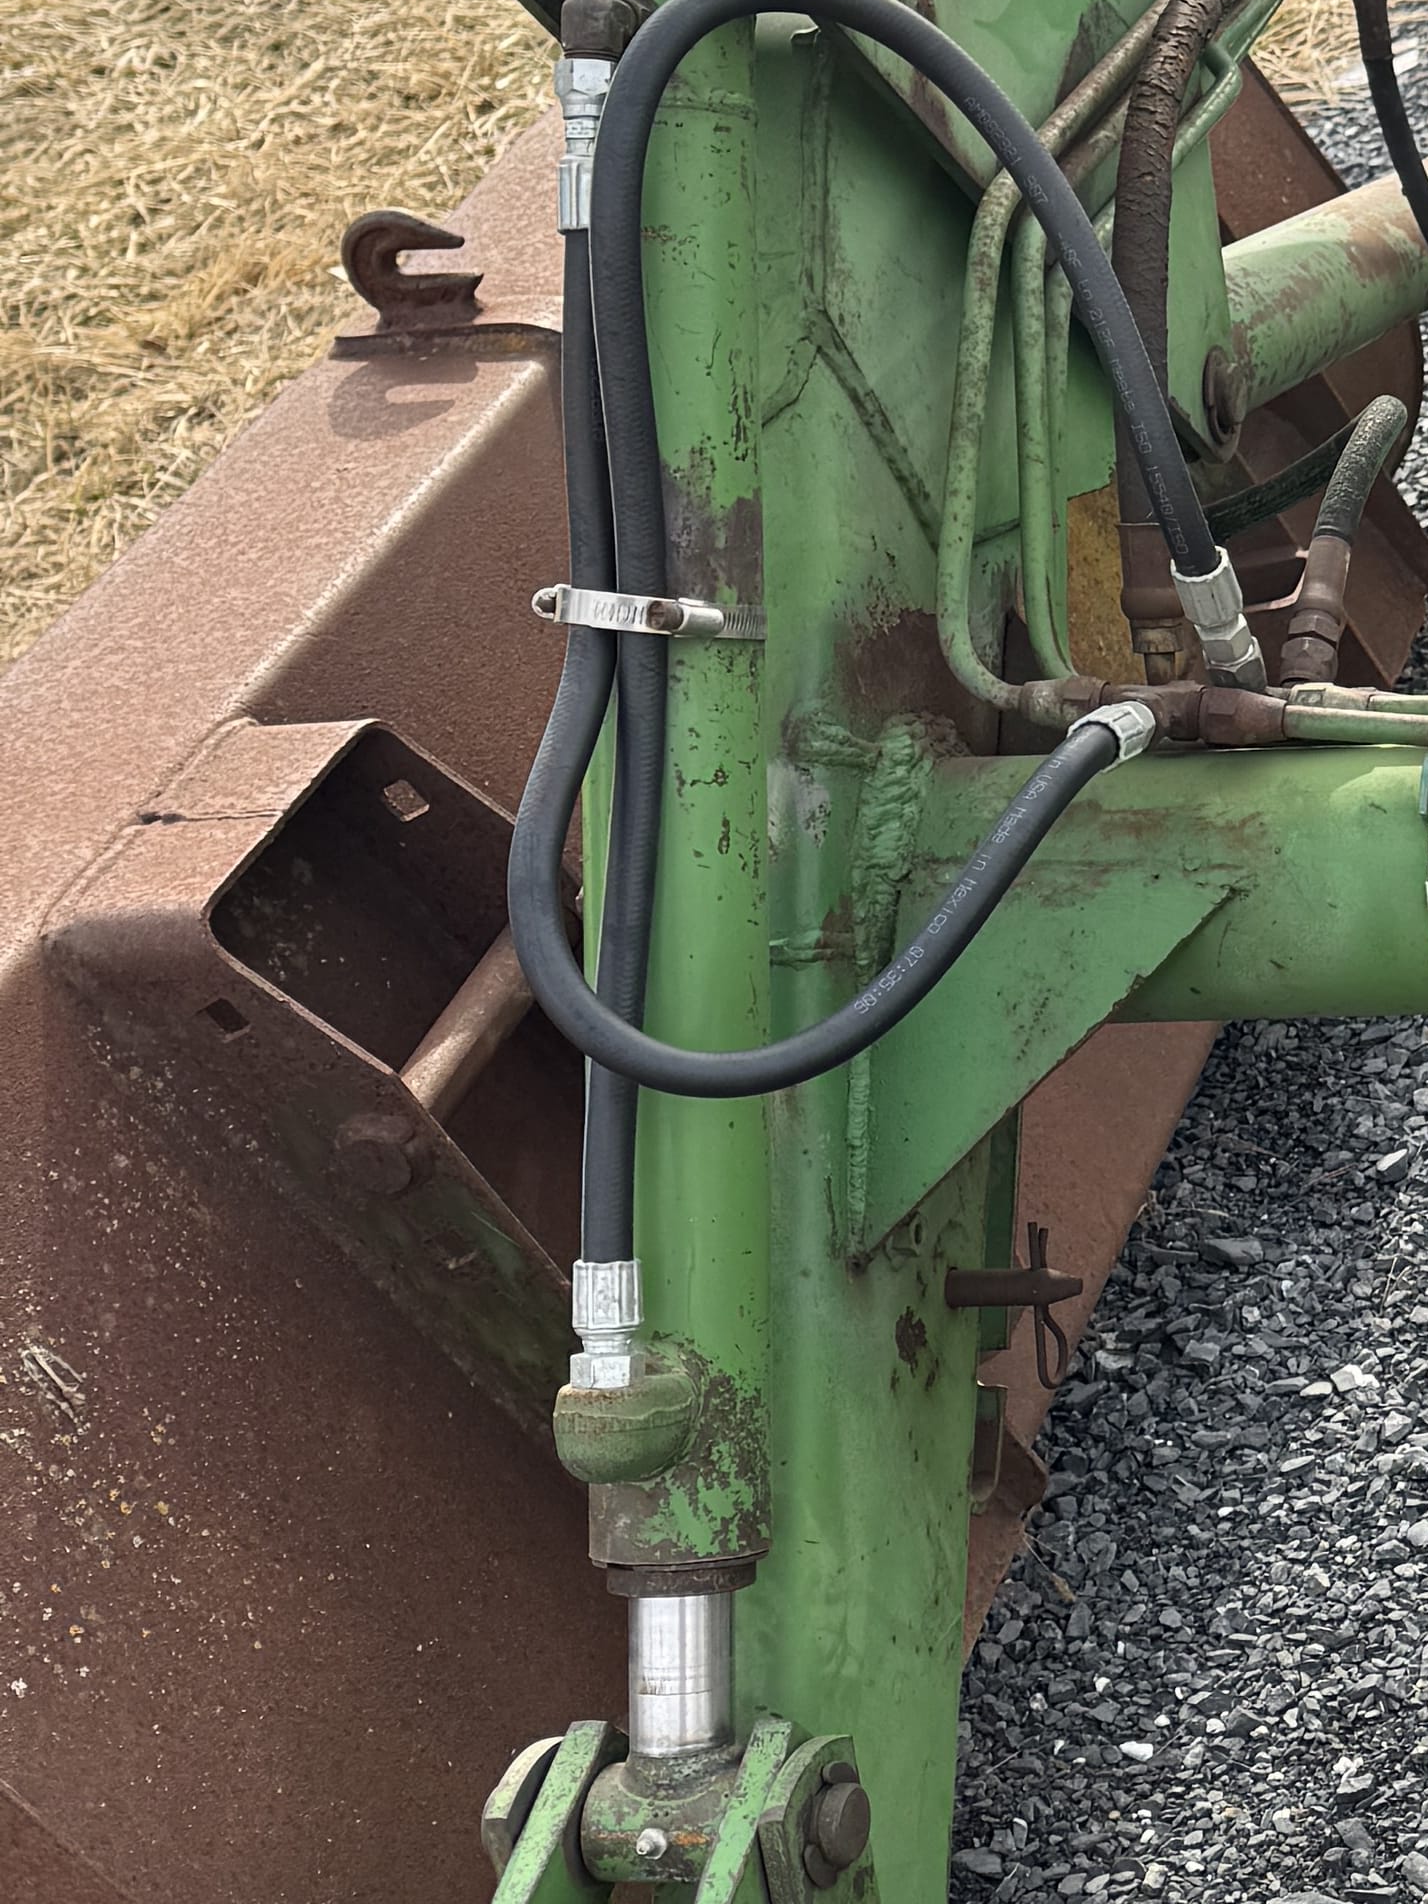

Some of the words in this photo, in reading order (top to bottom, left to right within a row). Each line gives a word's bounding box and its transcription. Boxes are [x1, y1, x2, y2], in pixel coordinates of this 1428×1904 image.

[1077, 279, 1093, 301] to
[1131, 422, 1152, 454] ISO
[1023, 774, 1053, 800] USA
[991, 806, 1027, 844] Made
[972, 853, 992, 871] in
[927, 877, 977, 934] Mexico
[853, 946, 925, 1014] 07:35:06
